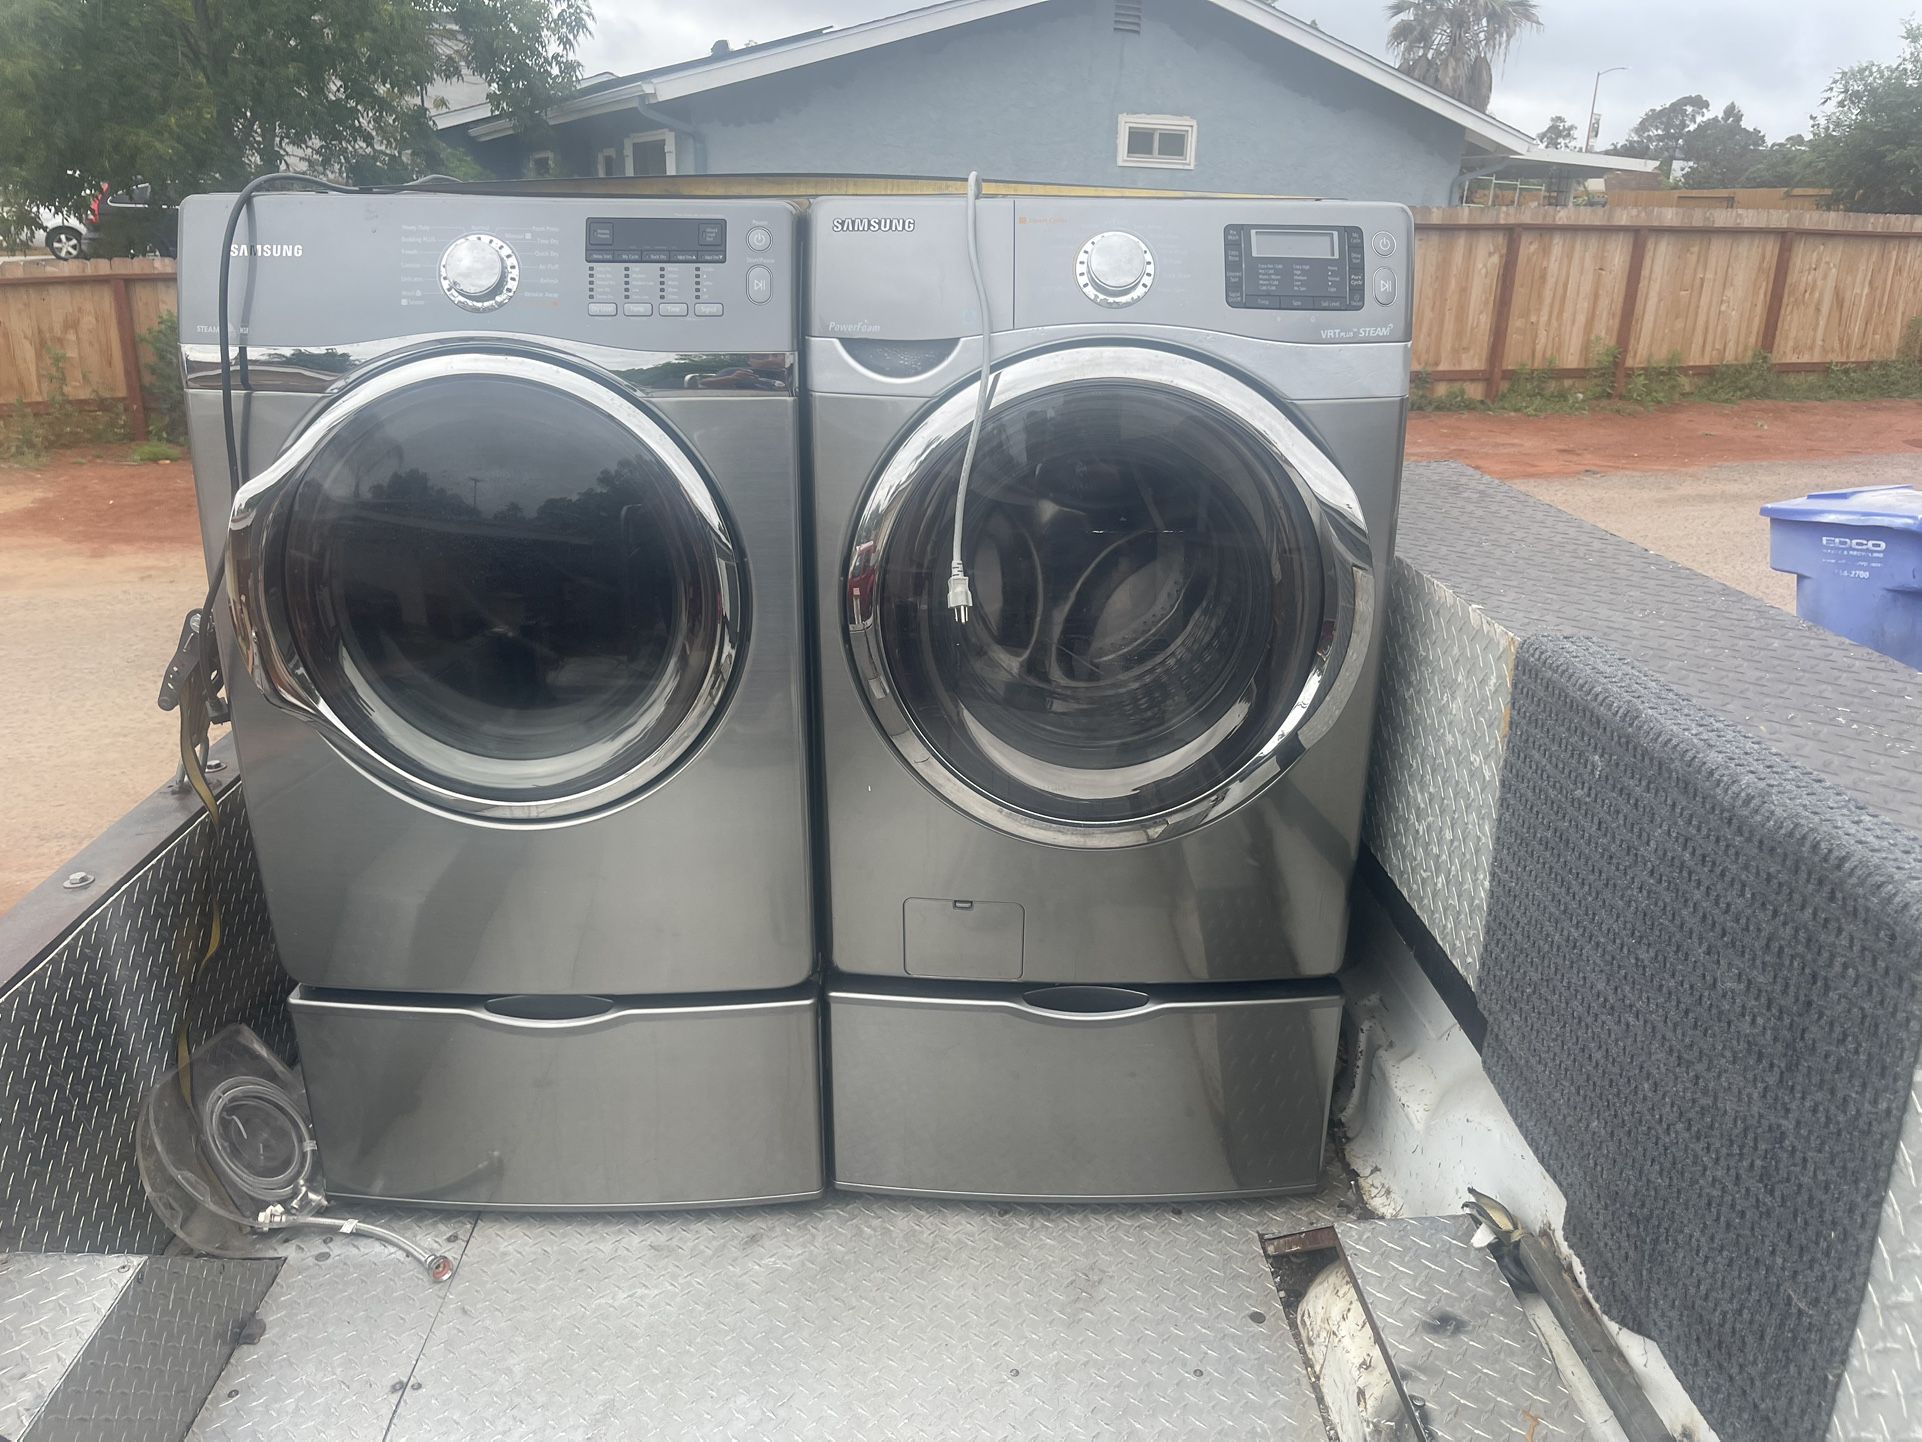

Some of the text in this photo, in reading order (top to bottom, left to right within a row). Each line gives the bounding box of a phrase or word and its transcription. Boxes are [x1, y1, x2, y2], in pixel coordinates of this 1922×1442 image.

[832, 218, 915, 232] SAMSUNG
[230, 244, 303, 257] SAMSUNG
[828, 320, 881, 333] PowerFoam
[1358, 326, 1390, 337] STEAM
[1822, 536, 1886, 551] EDCO
